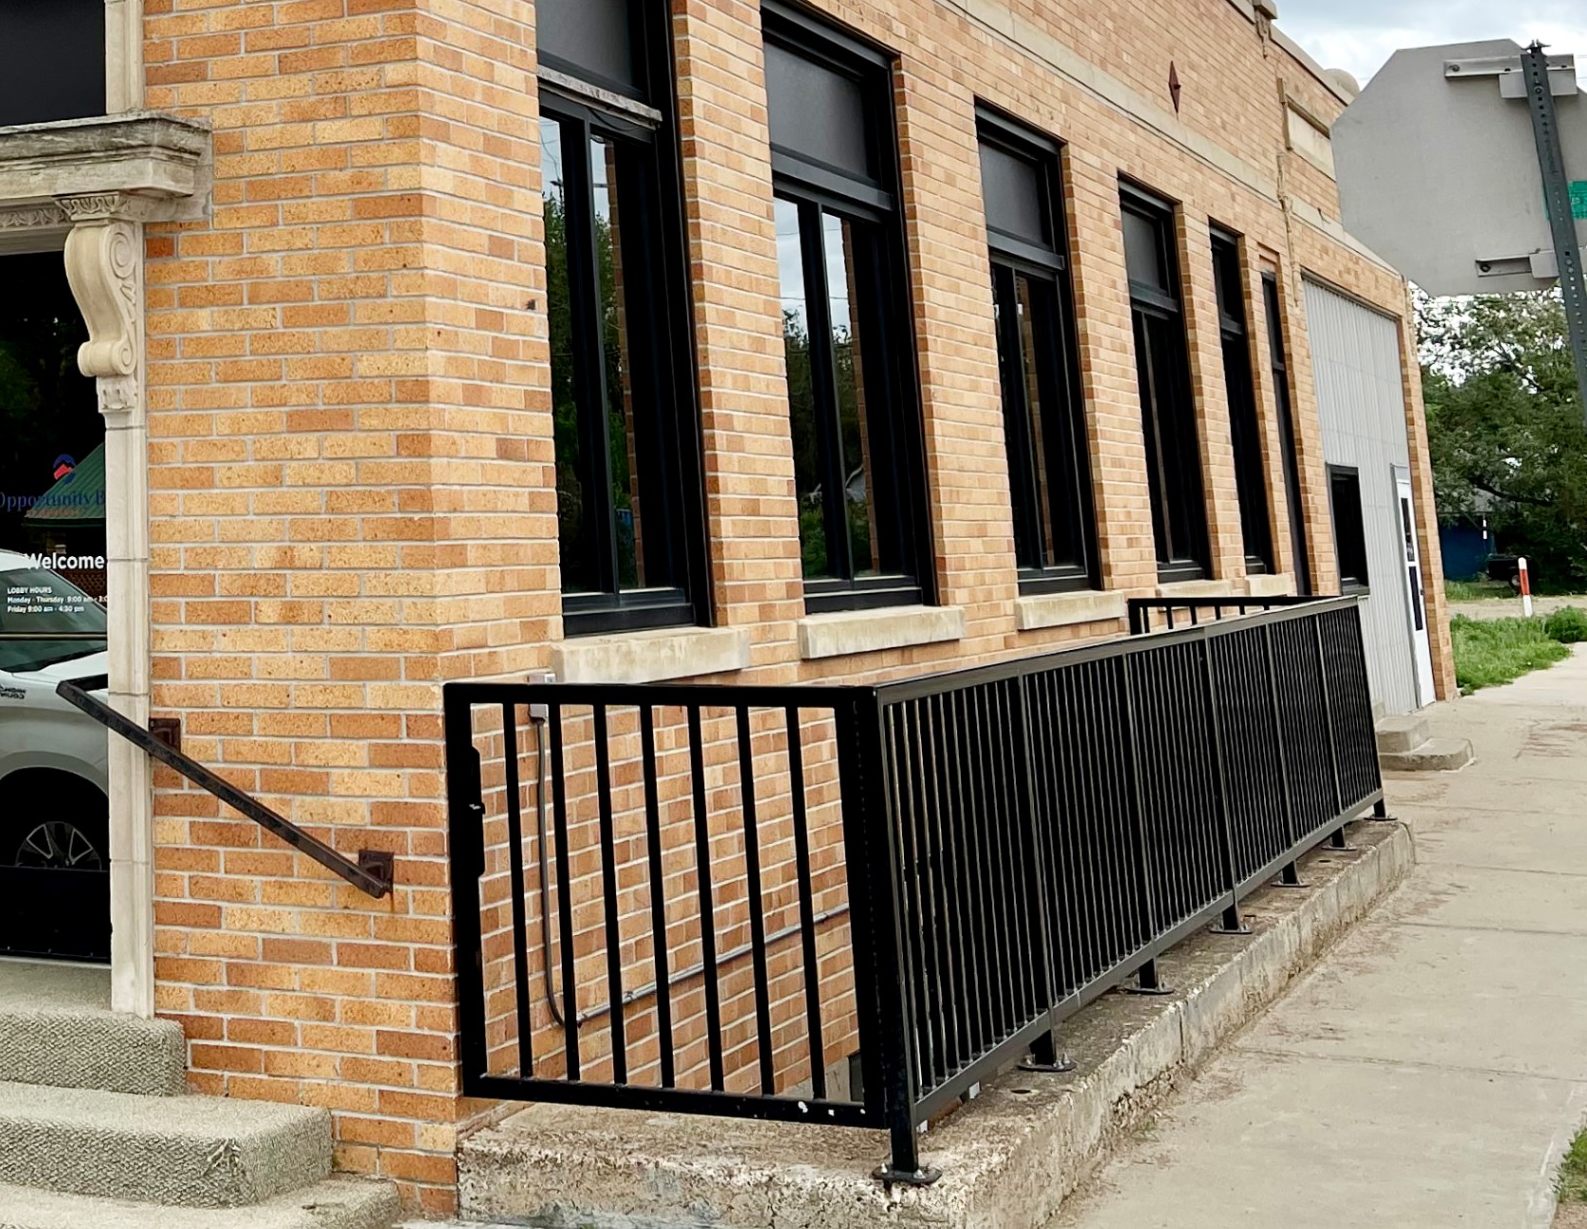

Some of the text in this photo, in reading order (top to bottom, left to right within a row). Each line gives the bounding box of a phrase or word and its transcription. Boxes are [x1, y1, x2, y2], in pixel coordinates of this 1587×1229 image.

[25, 552, 105, 570] Welcome
[7, 586, 52, 595] LOBBY HOURS
[7, 596, 31, 605] Monday
[36, 595, 64, 604] Thursday
[7, 605, 26, 613] Friday
